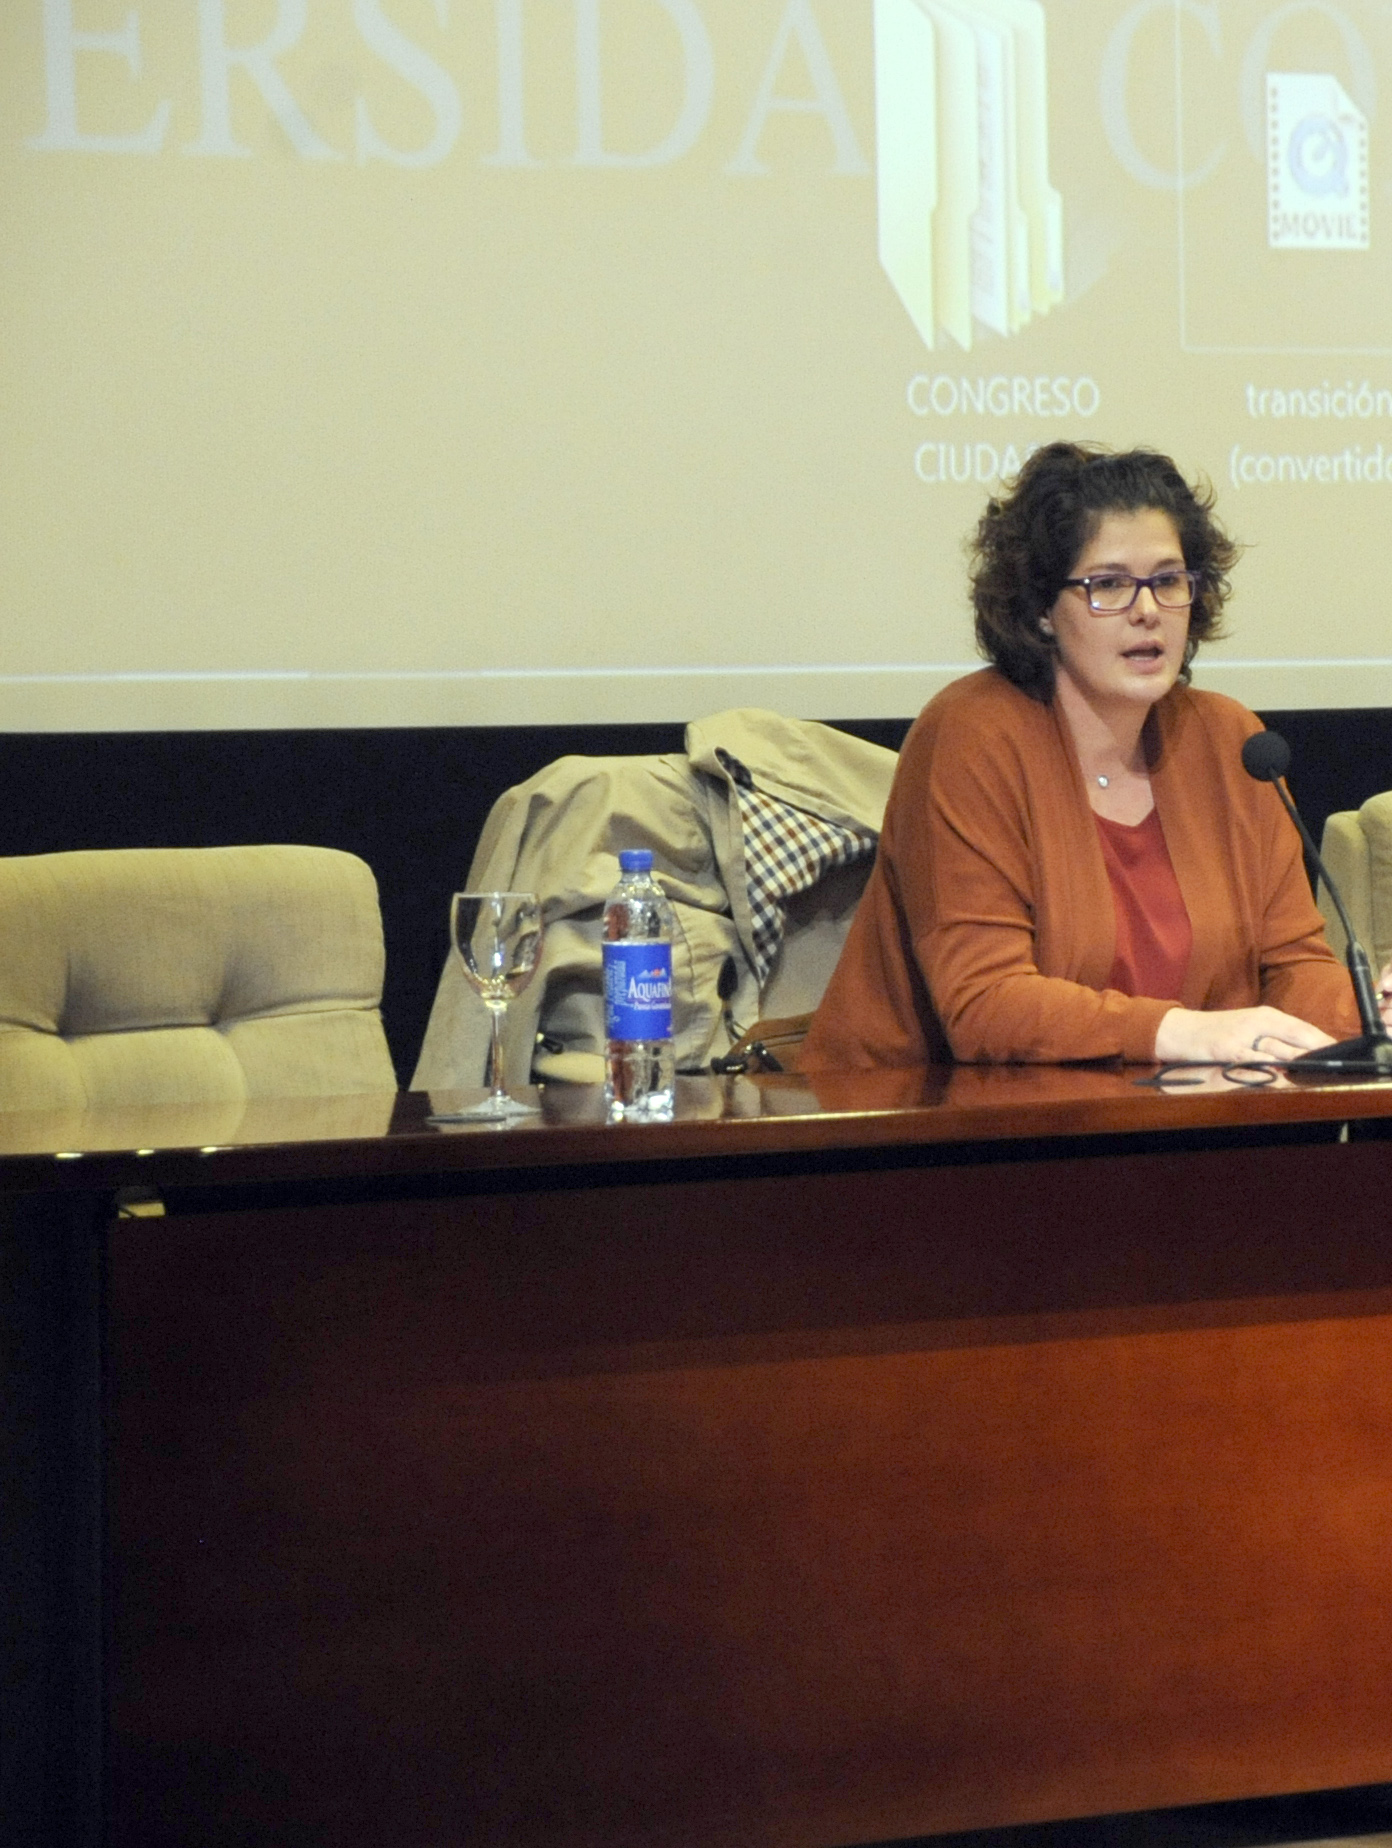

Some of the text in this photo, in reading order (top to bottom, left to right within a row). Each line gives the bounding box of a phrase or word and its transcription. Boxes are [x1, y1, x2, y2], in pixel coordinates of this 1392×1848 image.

[908, 373, 1101, 416] CONGRESO
[914, 442, 1040, 483] CIUDA
[627, 976, 672, 1003] AQUAFIN
